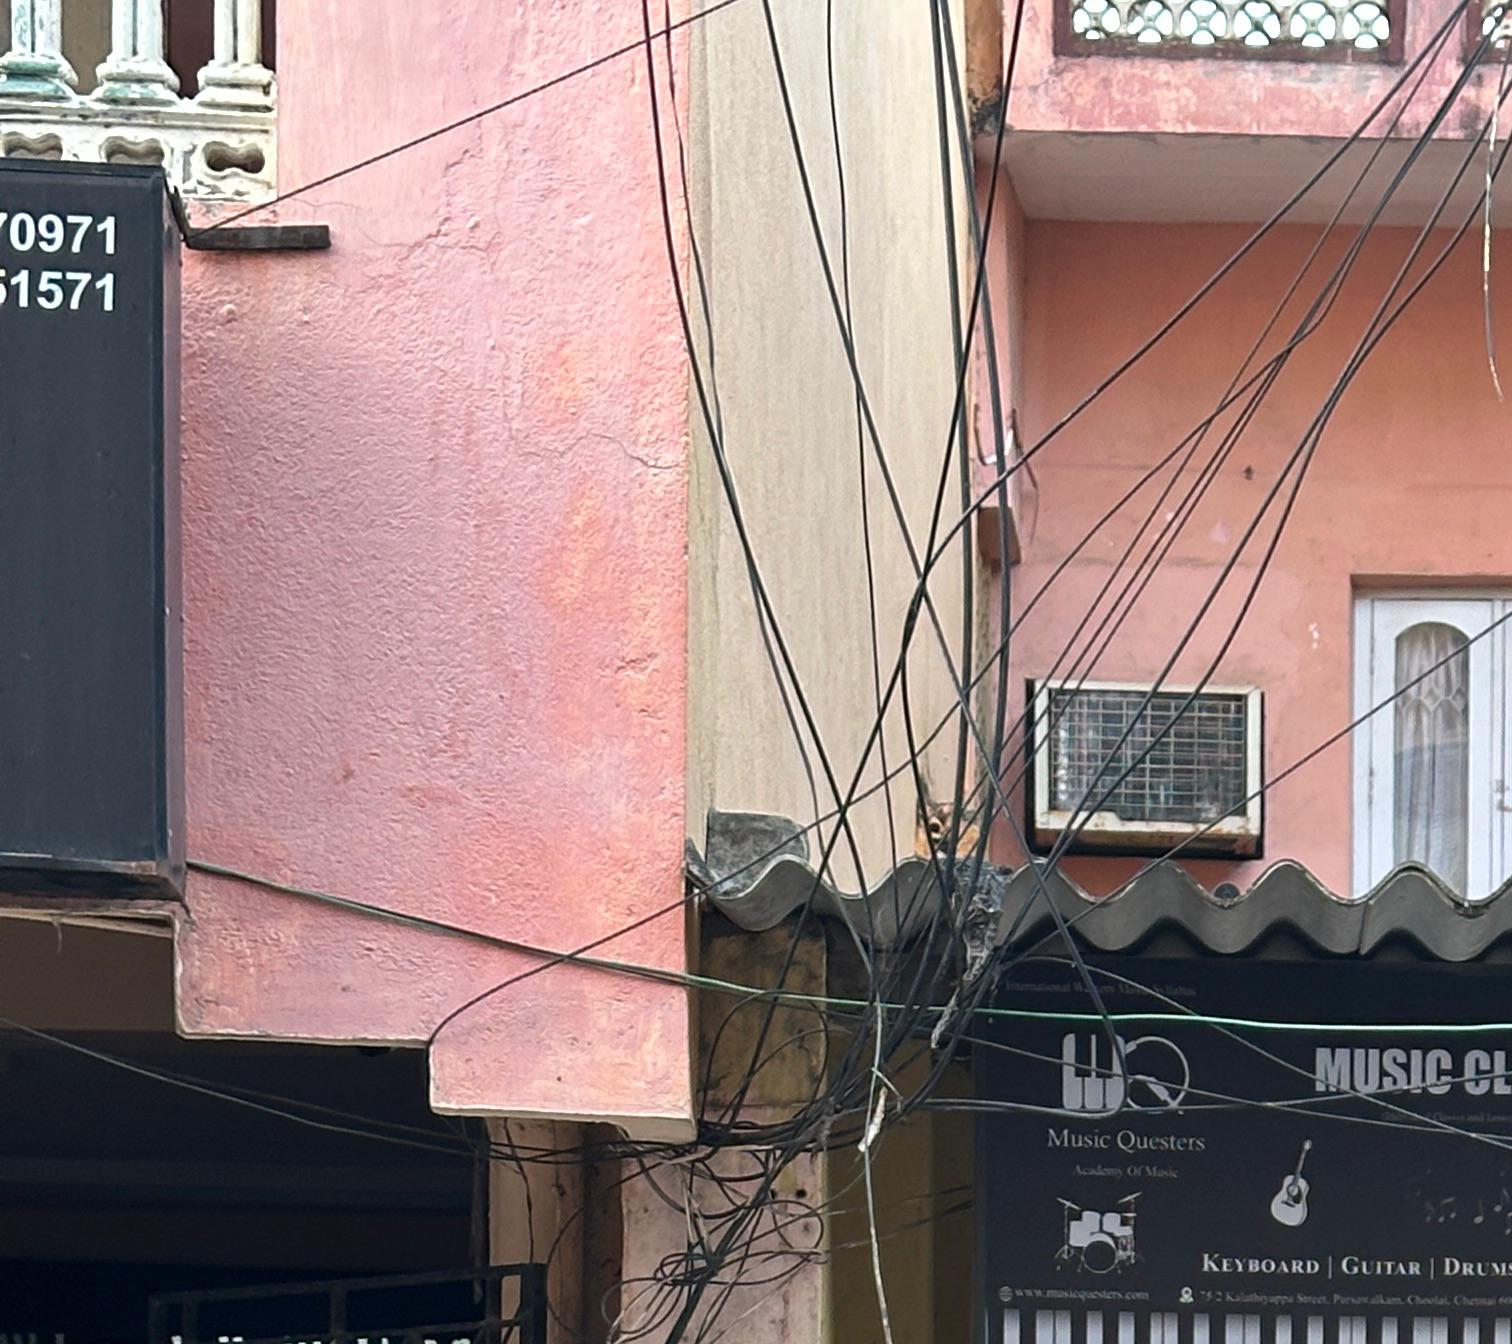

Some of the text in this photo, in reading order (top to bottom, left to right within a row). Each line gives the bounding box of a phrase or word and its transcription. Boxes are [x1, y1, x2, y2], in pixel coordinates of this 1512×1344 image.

[1314, 1047, 1453, 1096] MUSIC
[1047, 1128, 1206, 1154] Music Questers
[1202, 1252, 1320, 1275] KEYBOARD
[1341, 1255, 1422, 1277] GUITAR
